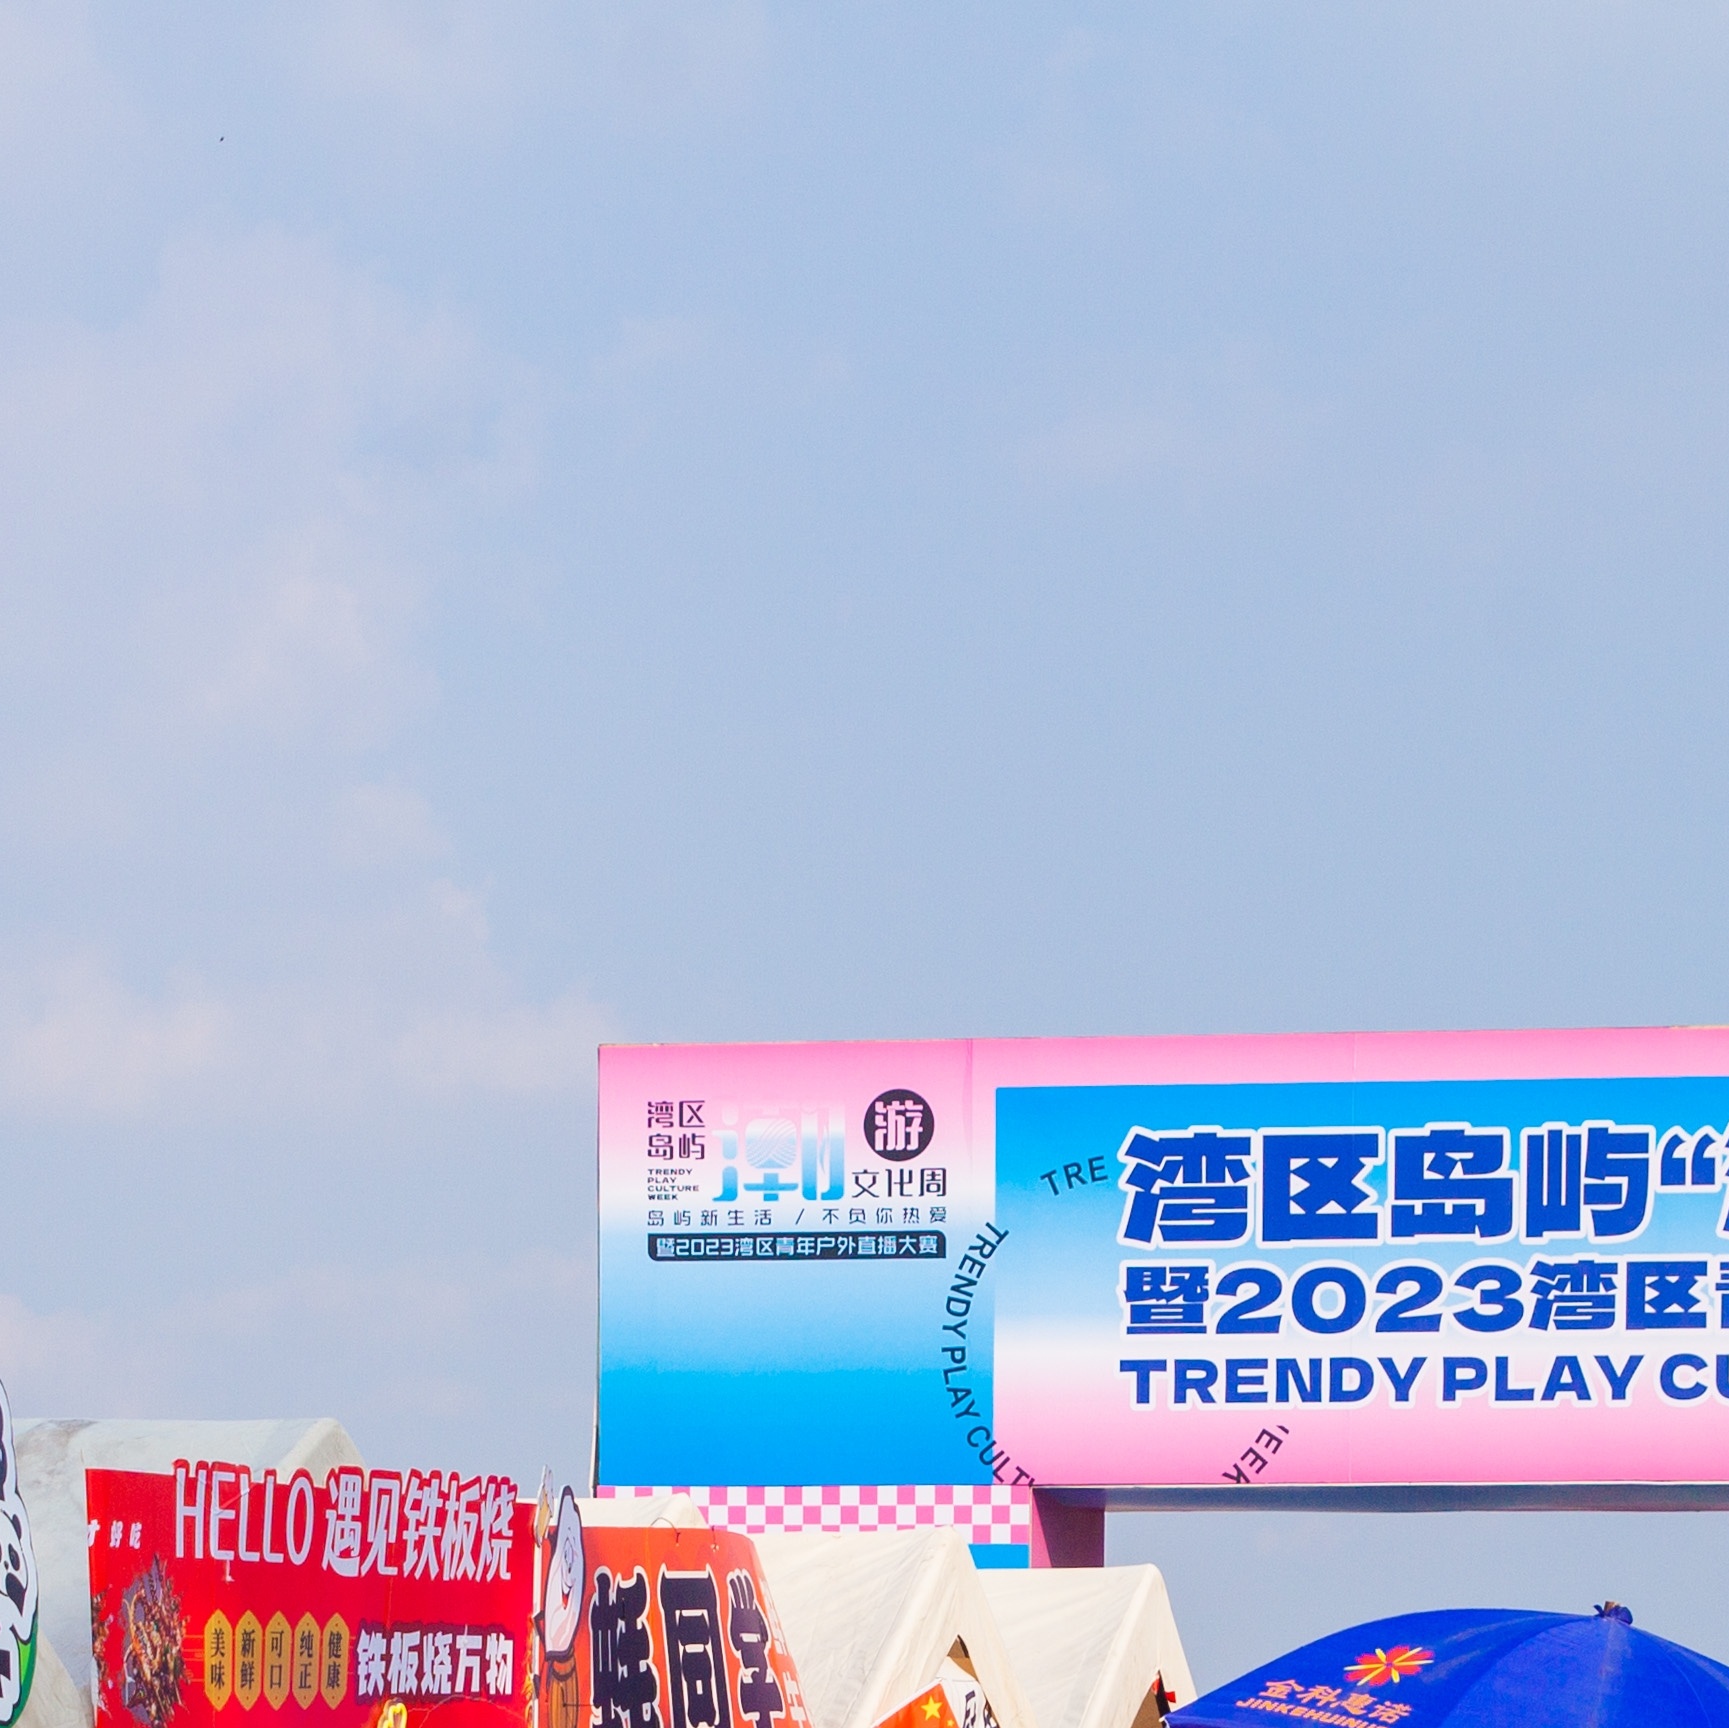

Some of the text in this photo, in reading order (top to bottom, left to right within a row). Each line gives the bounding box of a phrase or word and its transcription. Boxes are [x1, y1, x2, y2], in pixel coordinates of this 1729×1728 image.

[647, 1100, 706, 1129] 湾区
[874, 1099, 924, 1152] 游
[647, 1133, 706, 1161] 岛屿
[647, 1168, 693, 1176] TRENDY
[647, 1184, 700, 1193] CULTURE
[647, 1193, 679, 1201] WEEK
[851, 1167, 948, 1199] 文化周
[656, 1235, 939, 1258] 暨2023湾区青年户外直播大赛
[940, 1221, 1037, 1486] TRENDY PLAY CULT
[1119, 1356, 1428, 1404] TRENDY
[1443, 1354, 1648, 1403] PLAY
[173, 1462, 518, 1583] HELLO 遇见铁板烧
[209, 1627, 227, 1691] 美味
[239, 1627, 257, 1691] 新鲜
[268, 1629, 285, 1690] 可口
[298, 1630, 315, 1690] 纯正
[325, 1629, 343, 1690] 健康
